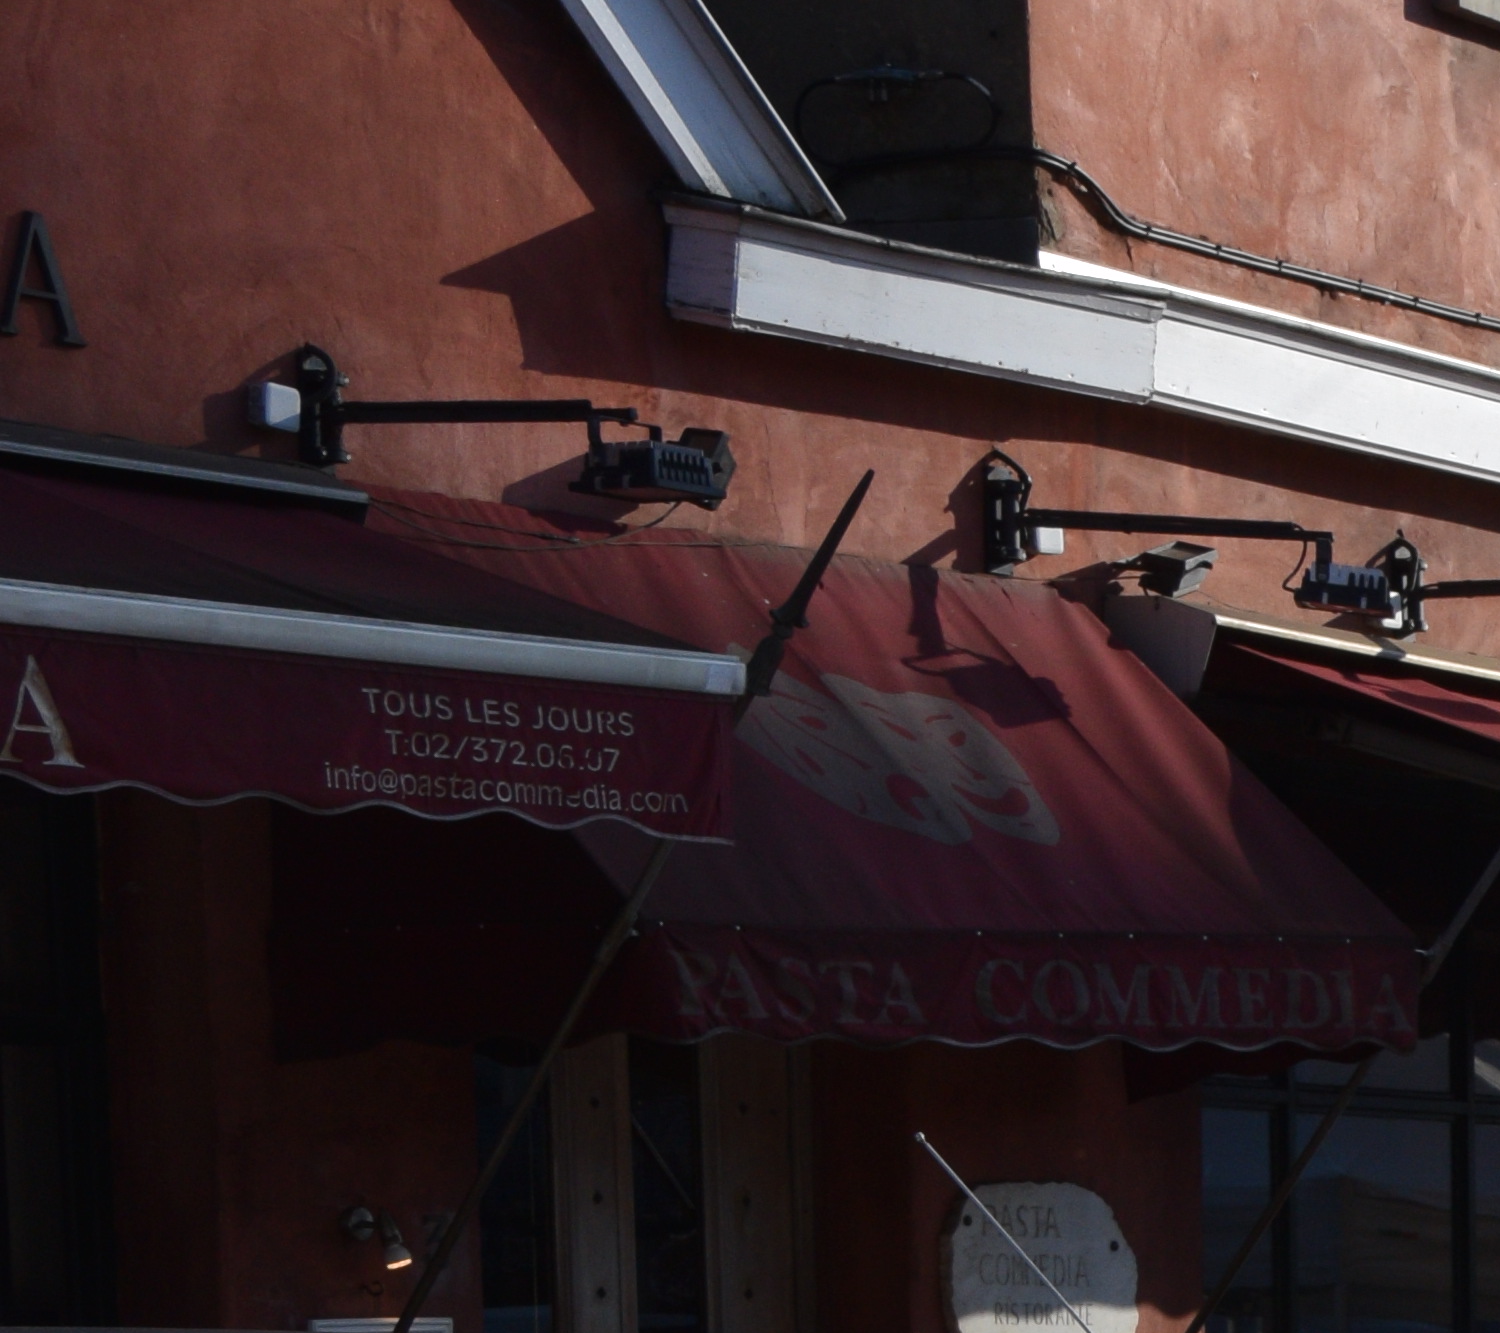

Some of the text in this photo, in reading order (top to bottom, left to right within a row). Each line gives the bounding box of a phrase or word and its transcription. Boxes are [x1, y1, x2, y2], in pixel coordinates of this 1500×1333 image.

[361, 687, 636, 737] TOUS LES JOURS
[670, 947, 1413, 1034] PASTA COMMEDIA
[981, 1204, 1062, 1239] PASTA
[994, 1302, 1094, 1326] RISTORANTE
